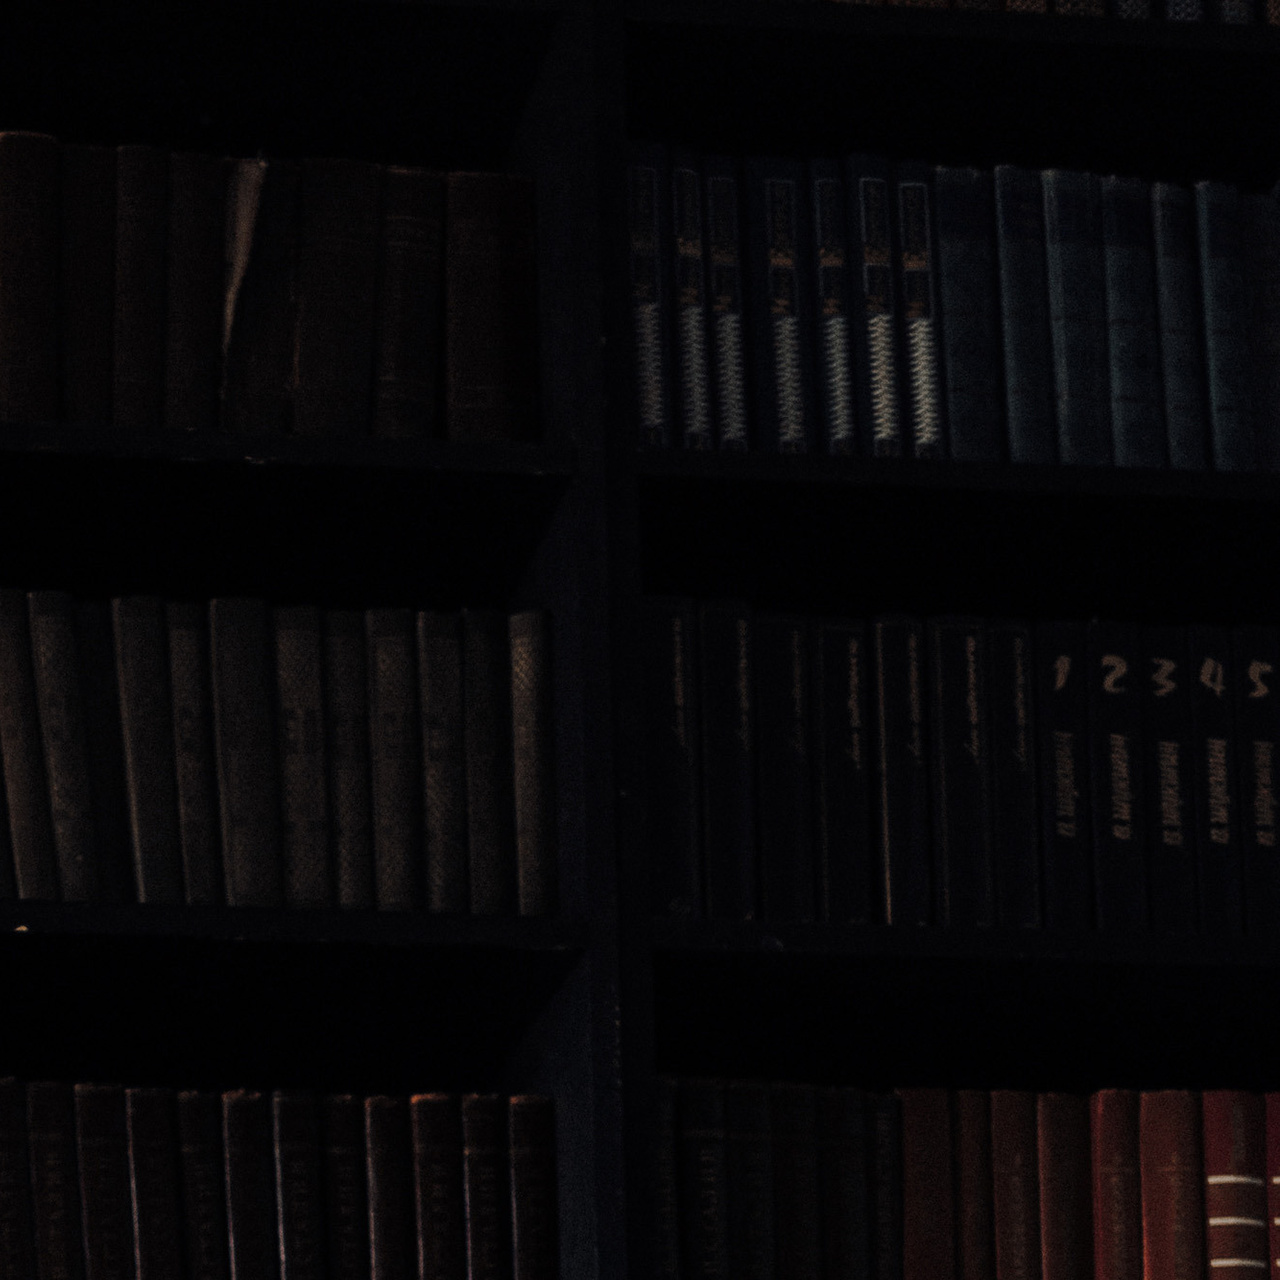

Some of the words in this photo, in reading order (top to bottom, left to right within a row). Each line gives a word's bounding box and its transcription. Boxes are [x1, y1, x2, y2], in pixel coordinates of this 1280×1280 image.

[1052, 654, 1073, 692] 1
[1100, 653, 1130, 695] 2
[1149, 656, 1178, 698] 3
[1198, 656, 1225, 699] 4
[1247, 658, 1274, 698] 5
